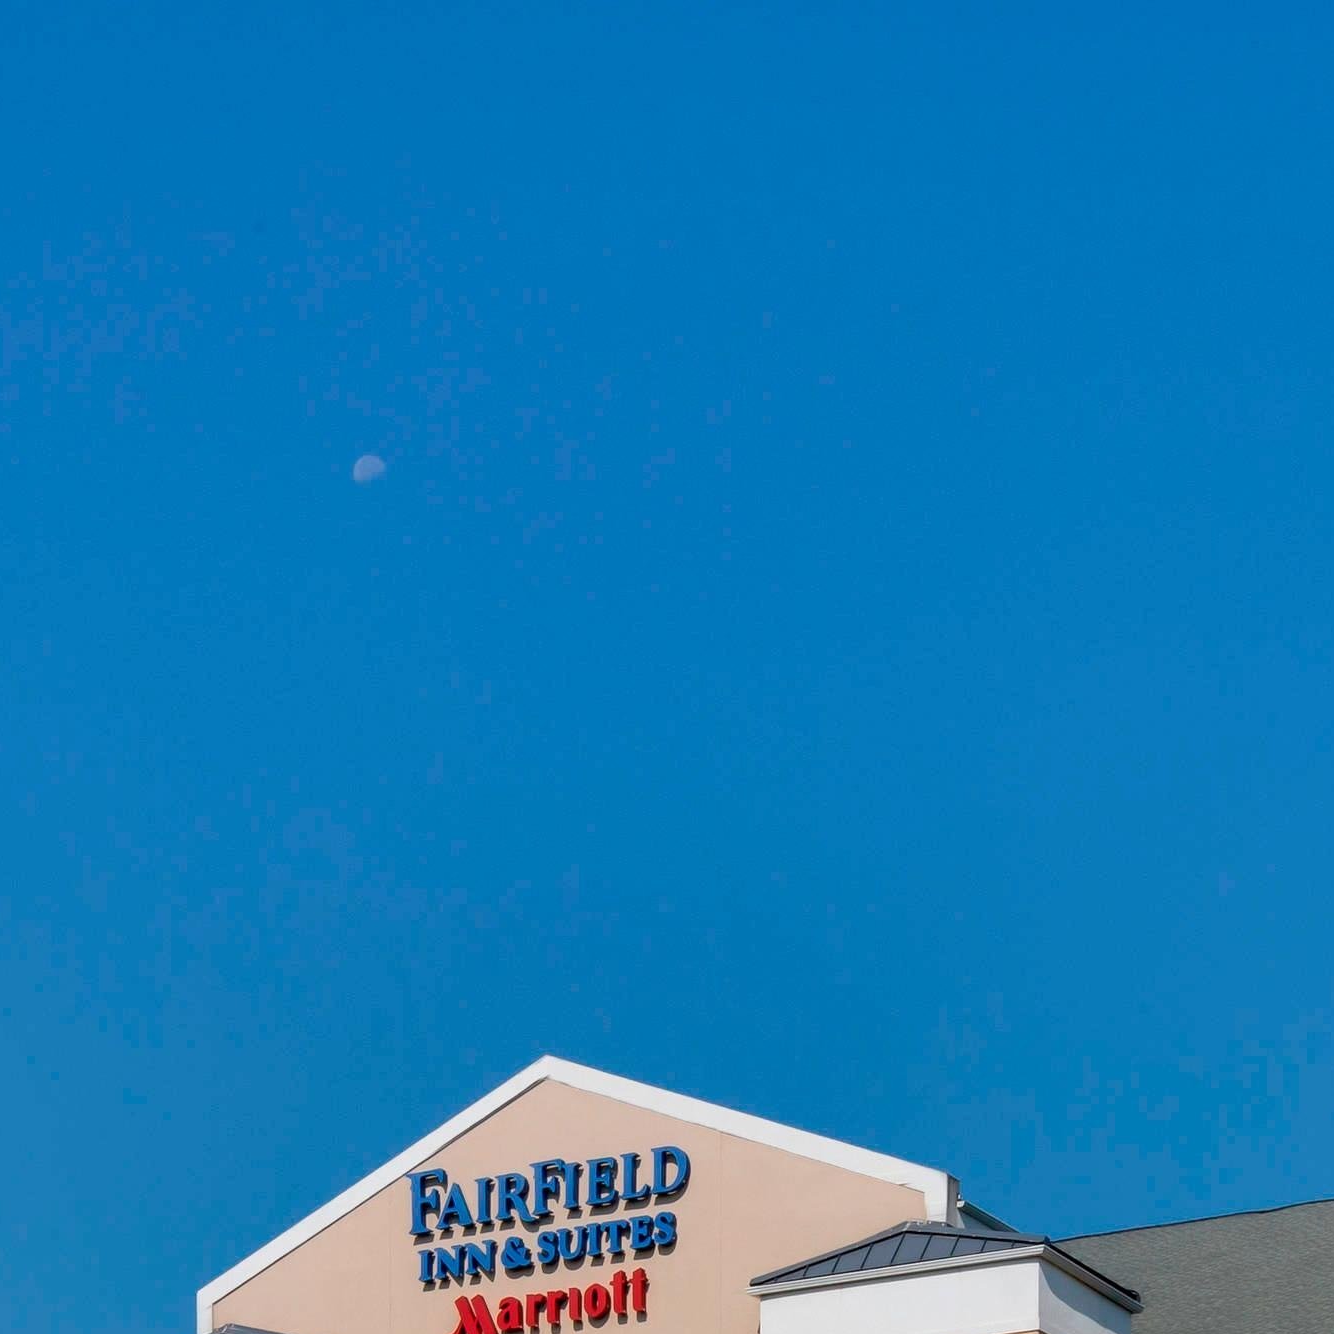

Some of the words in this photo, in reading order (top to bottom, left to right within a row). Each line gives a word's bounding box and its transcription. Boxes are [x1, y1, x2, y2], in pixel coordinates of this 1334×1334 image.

[407, 1146, 691, 1237] FAIRFIELD
[418, 1239, 498, 1283] INN
[500, 1236, 532, 1272] &
[537, 1211, 678, 1265] SUITES
